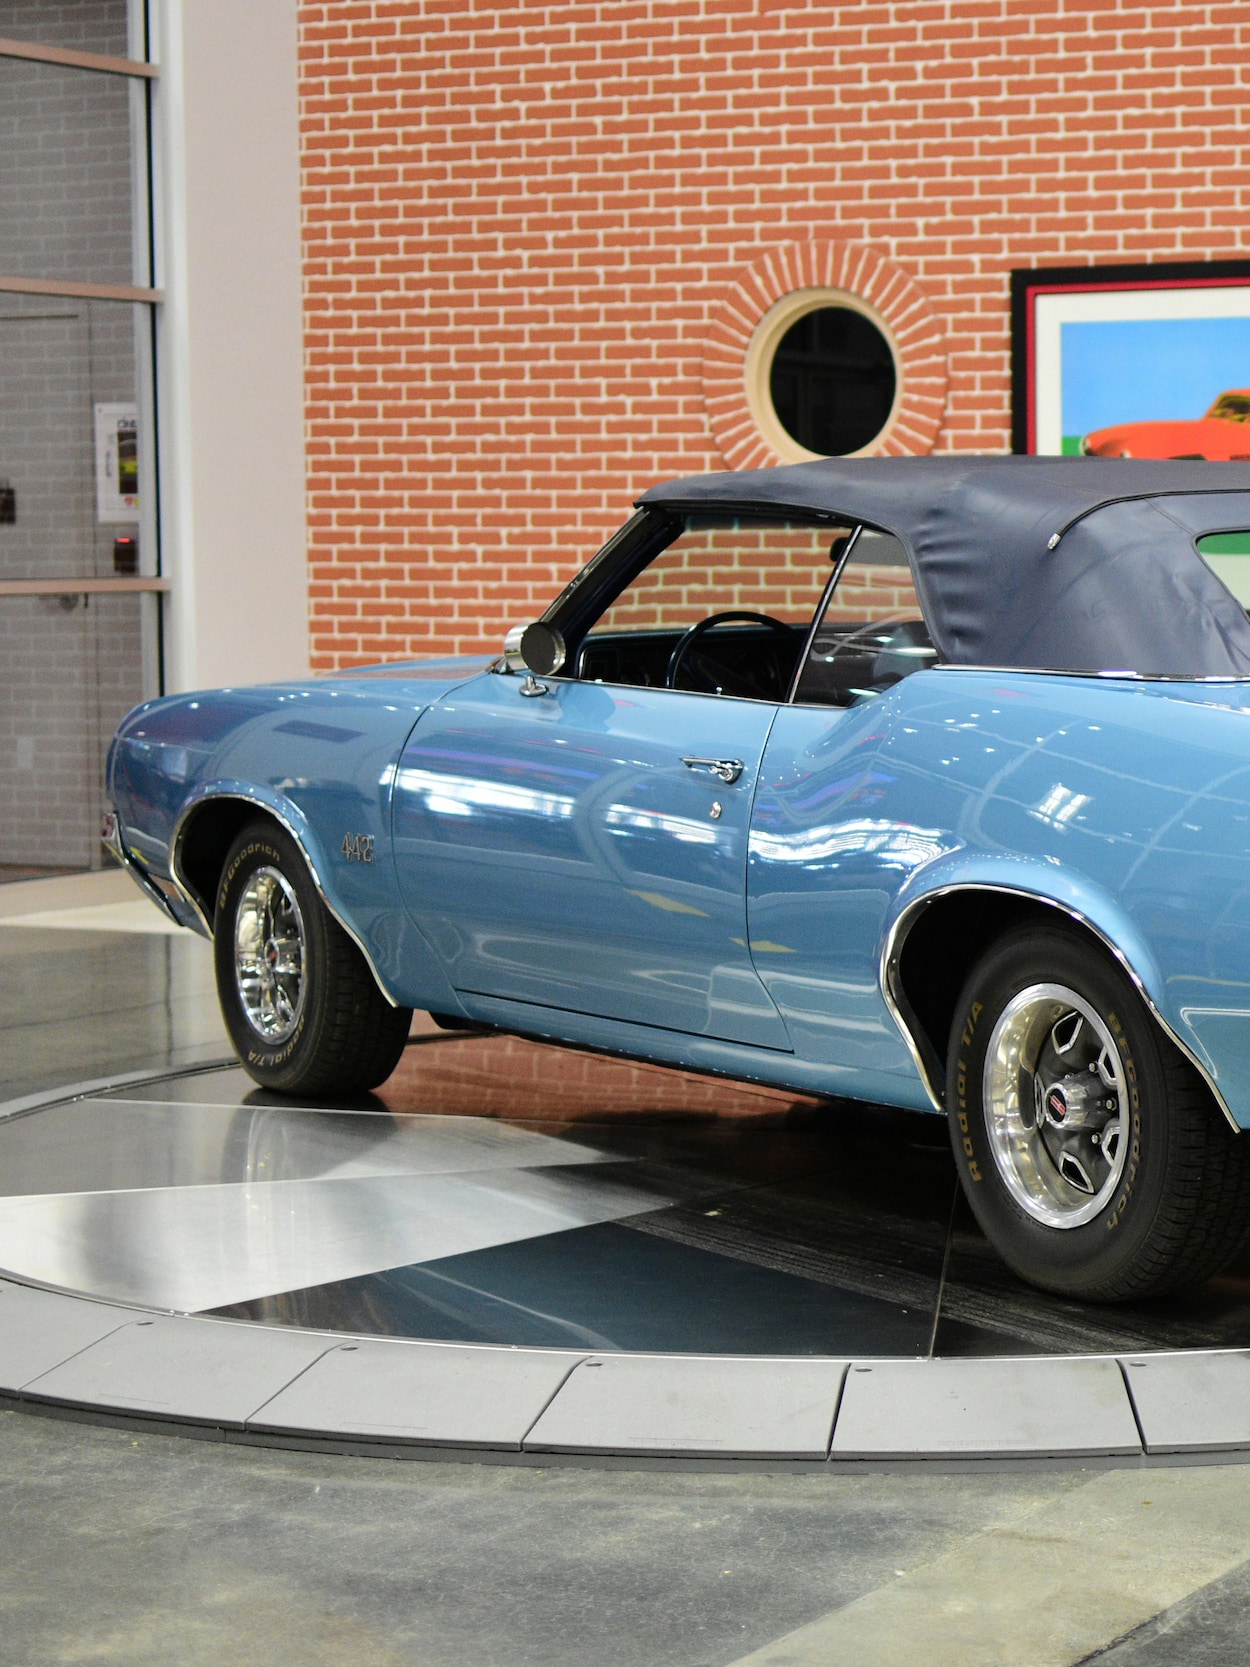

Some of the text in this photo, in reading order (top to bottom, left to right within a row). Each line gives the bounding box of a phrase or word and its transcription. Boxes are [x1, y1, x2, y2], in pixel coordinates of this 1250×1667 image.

[220, 842, 280, 909] BFGoodrich
[342, 832, 374, 863] 442
[957, 1001, 984, 1182] Radial T/A
[1108, 1012, 1141, 1230] BFGoodrich
